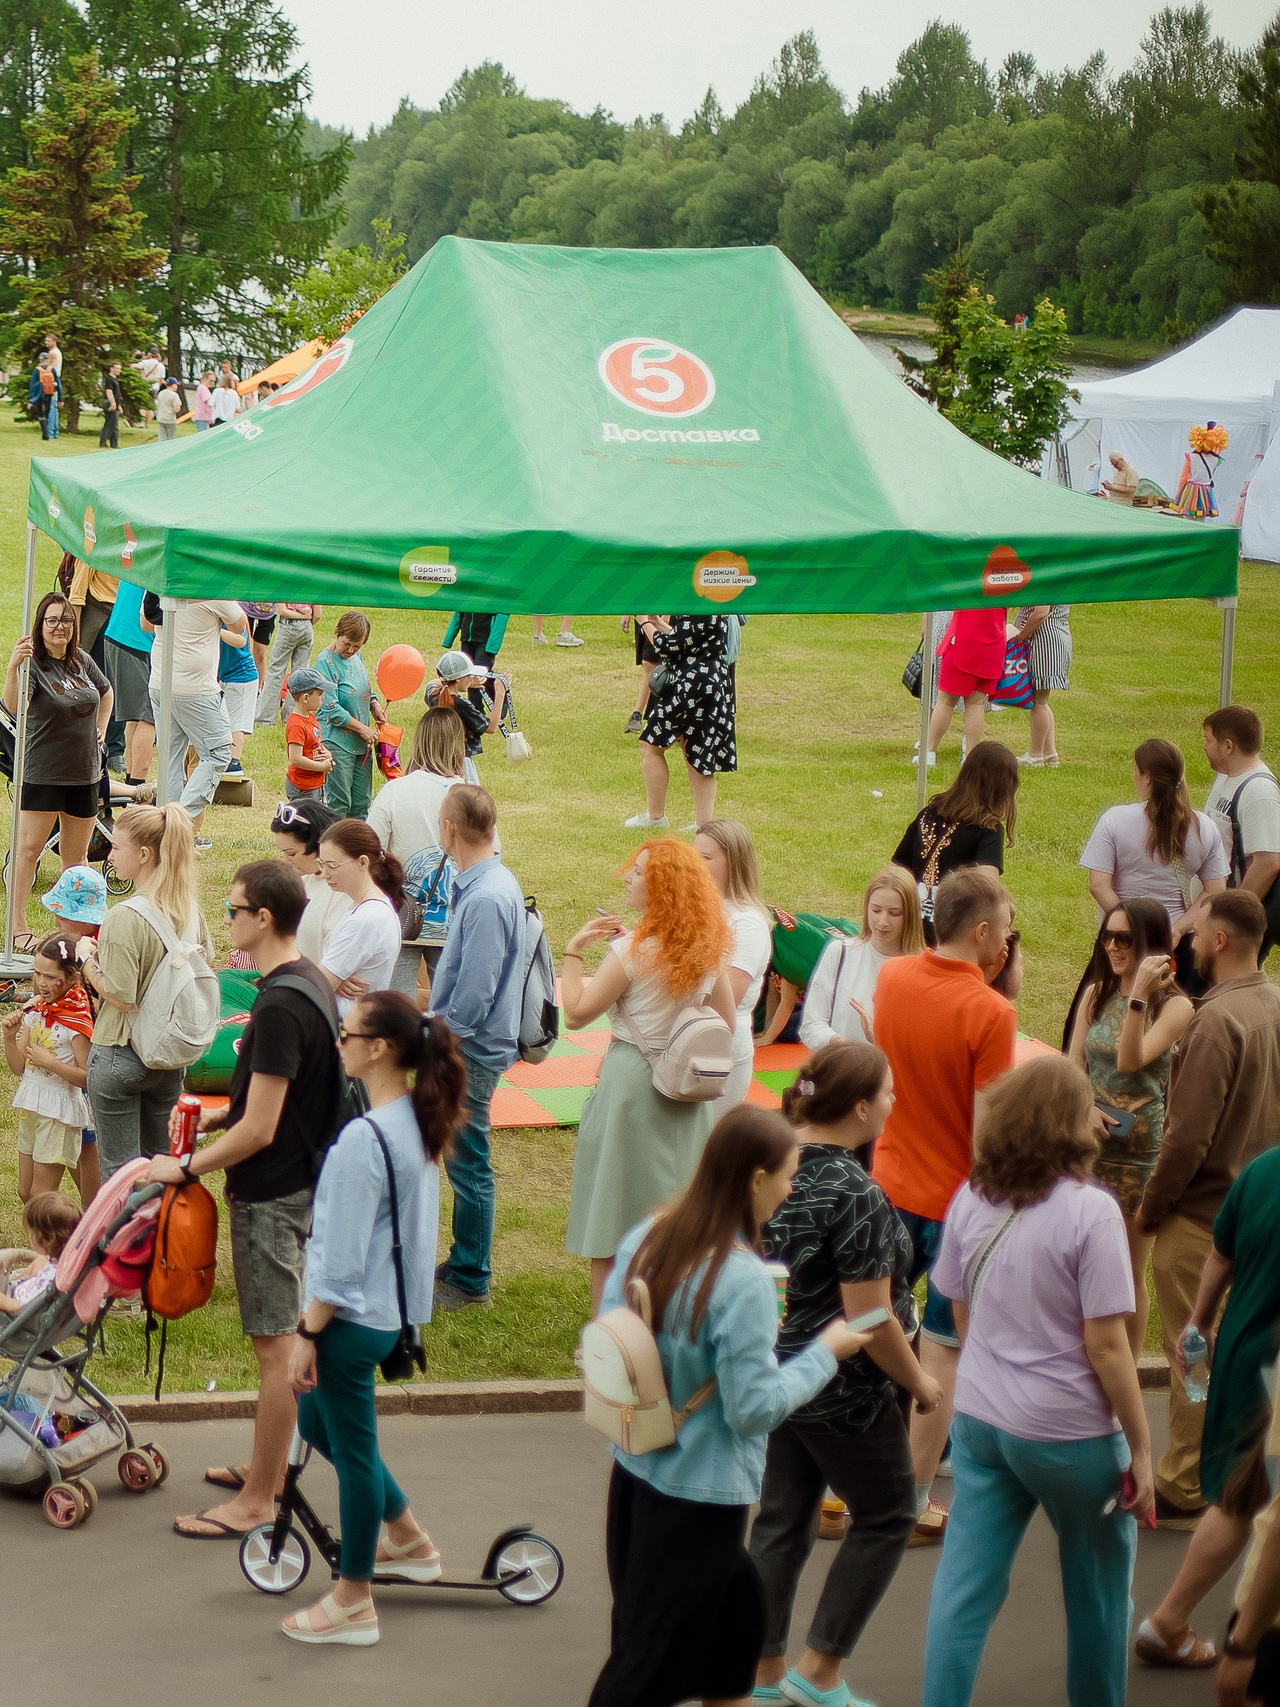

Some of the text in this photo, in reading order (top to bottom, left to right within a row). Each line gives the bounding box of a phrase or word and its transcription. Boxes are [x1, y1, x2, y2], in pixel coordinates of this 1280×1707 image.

[601, 422, 761, 443] Доставка
[414, 565, 452, 574] Гарантия
[703, 569, 736, 577] Держим
[732, 577, 752, 585] цены
[991, 574, 1019, 583] забота
